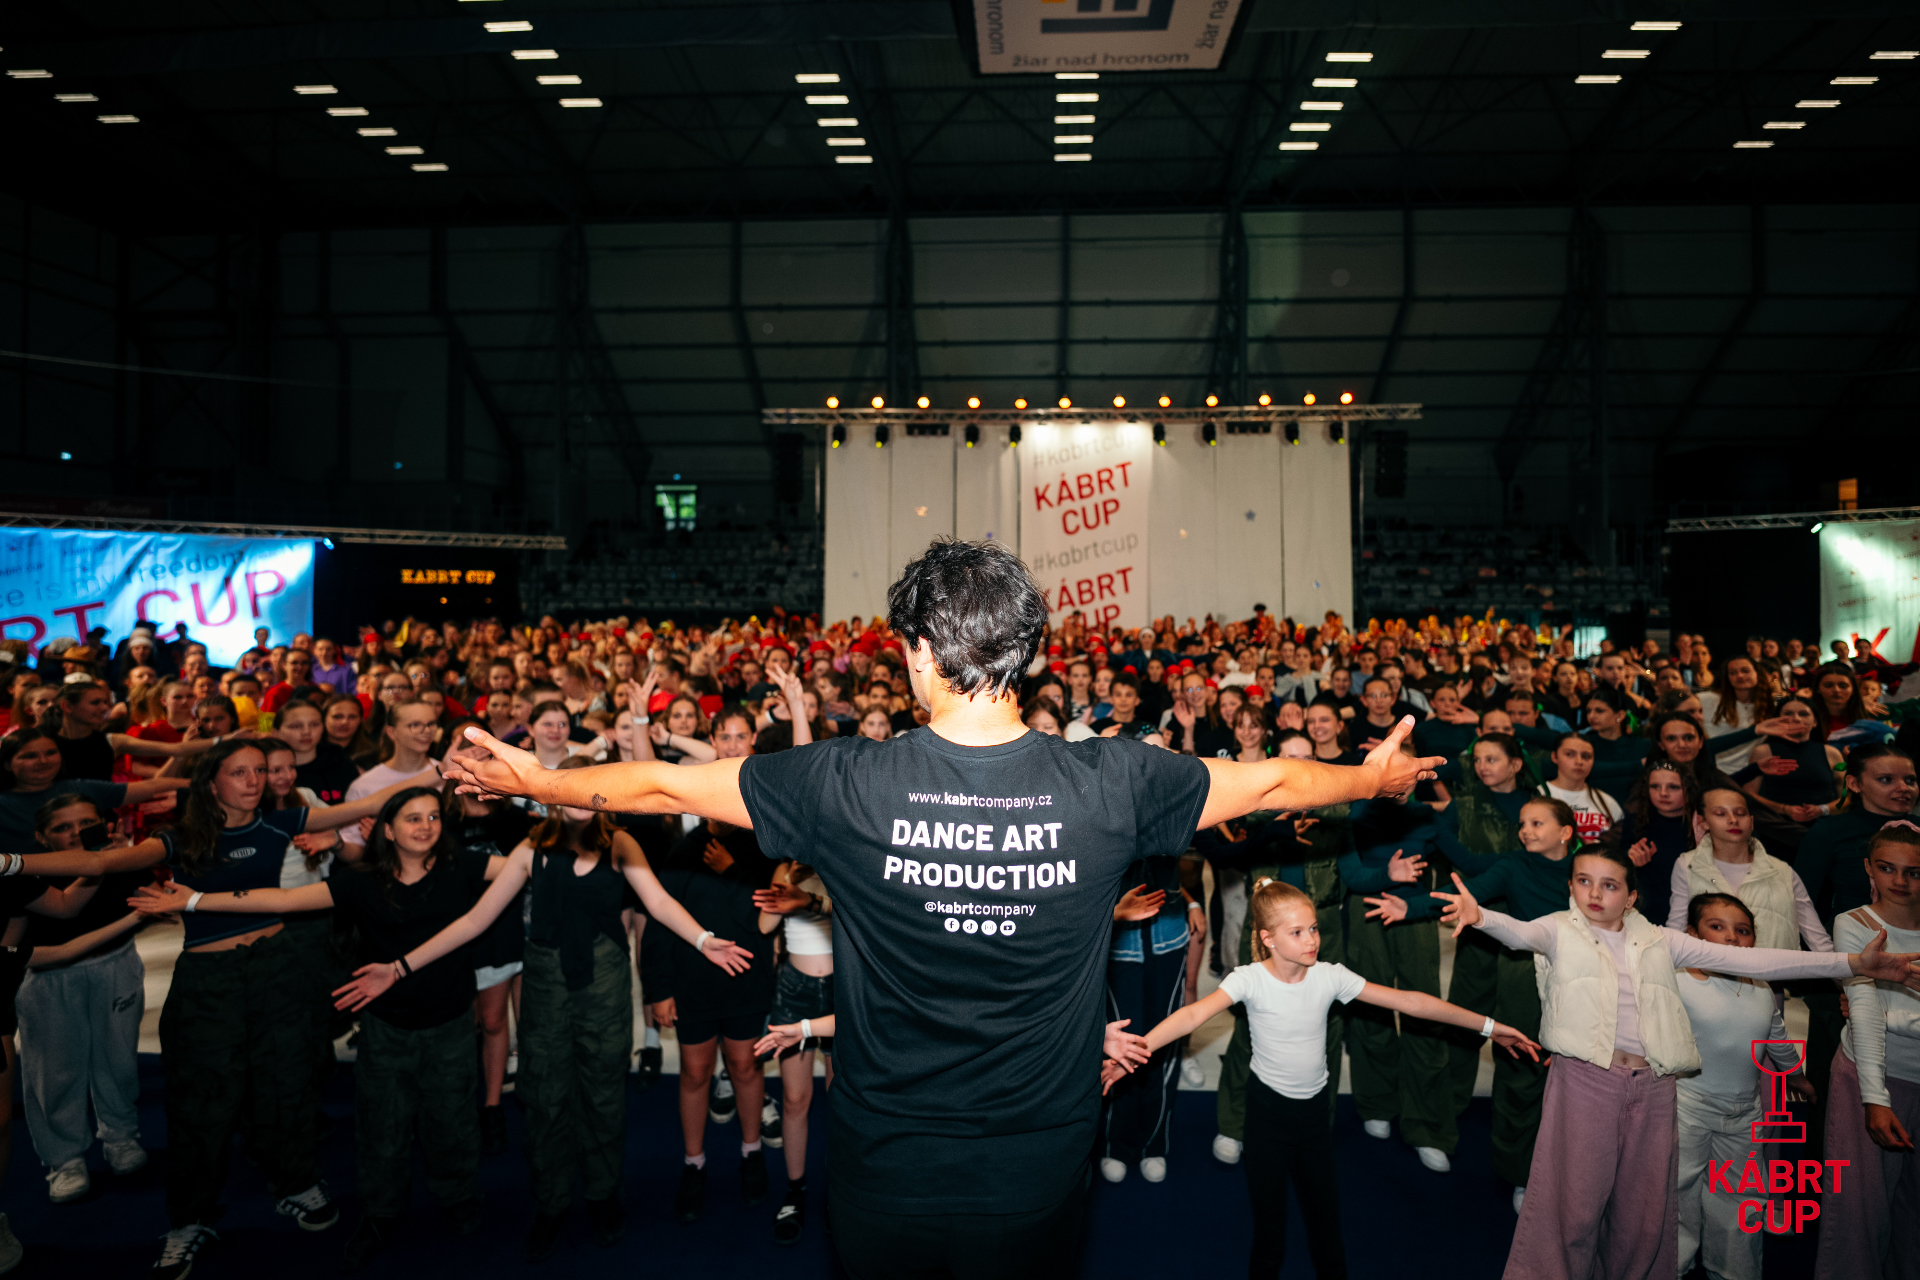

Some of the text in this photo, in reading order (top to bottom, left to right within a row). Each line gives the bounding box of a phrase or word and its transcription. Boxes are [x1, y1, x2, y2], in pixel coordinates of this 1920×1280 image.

[1012, 51, 1190, 67] žiar nad hronom
[1034, 461, 1132, 511] KÁBRT
[1062, 498, 1120, 536] CUP
[1033, 533, 1139, 572] #kabrtcup
[137, 570, 286, 640] CUP
[908, 792, 1053, 810] www.kabrtcompany.cz
[891, 818, 1063, 851] DANCE ART
[883, 855, 1076, 890] PRODUCTION
[924, 901, 1036, 918] @kabrtcompany
